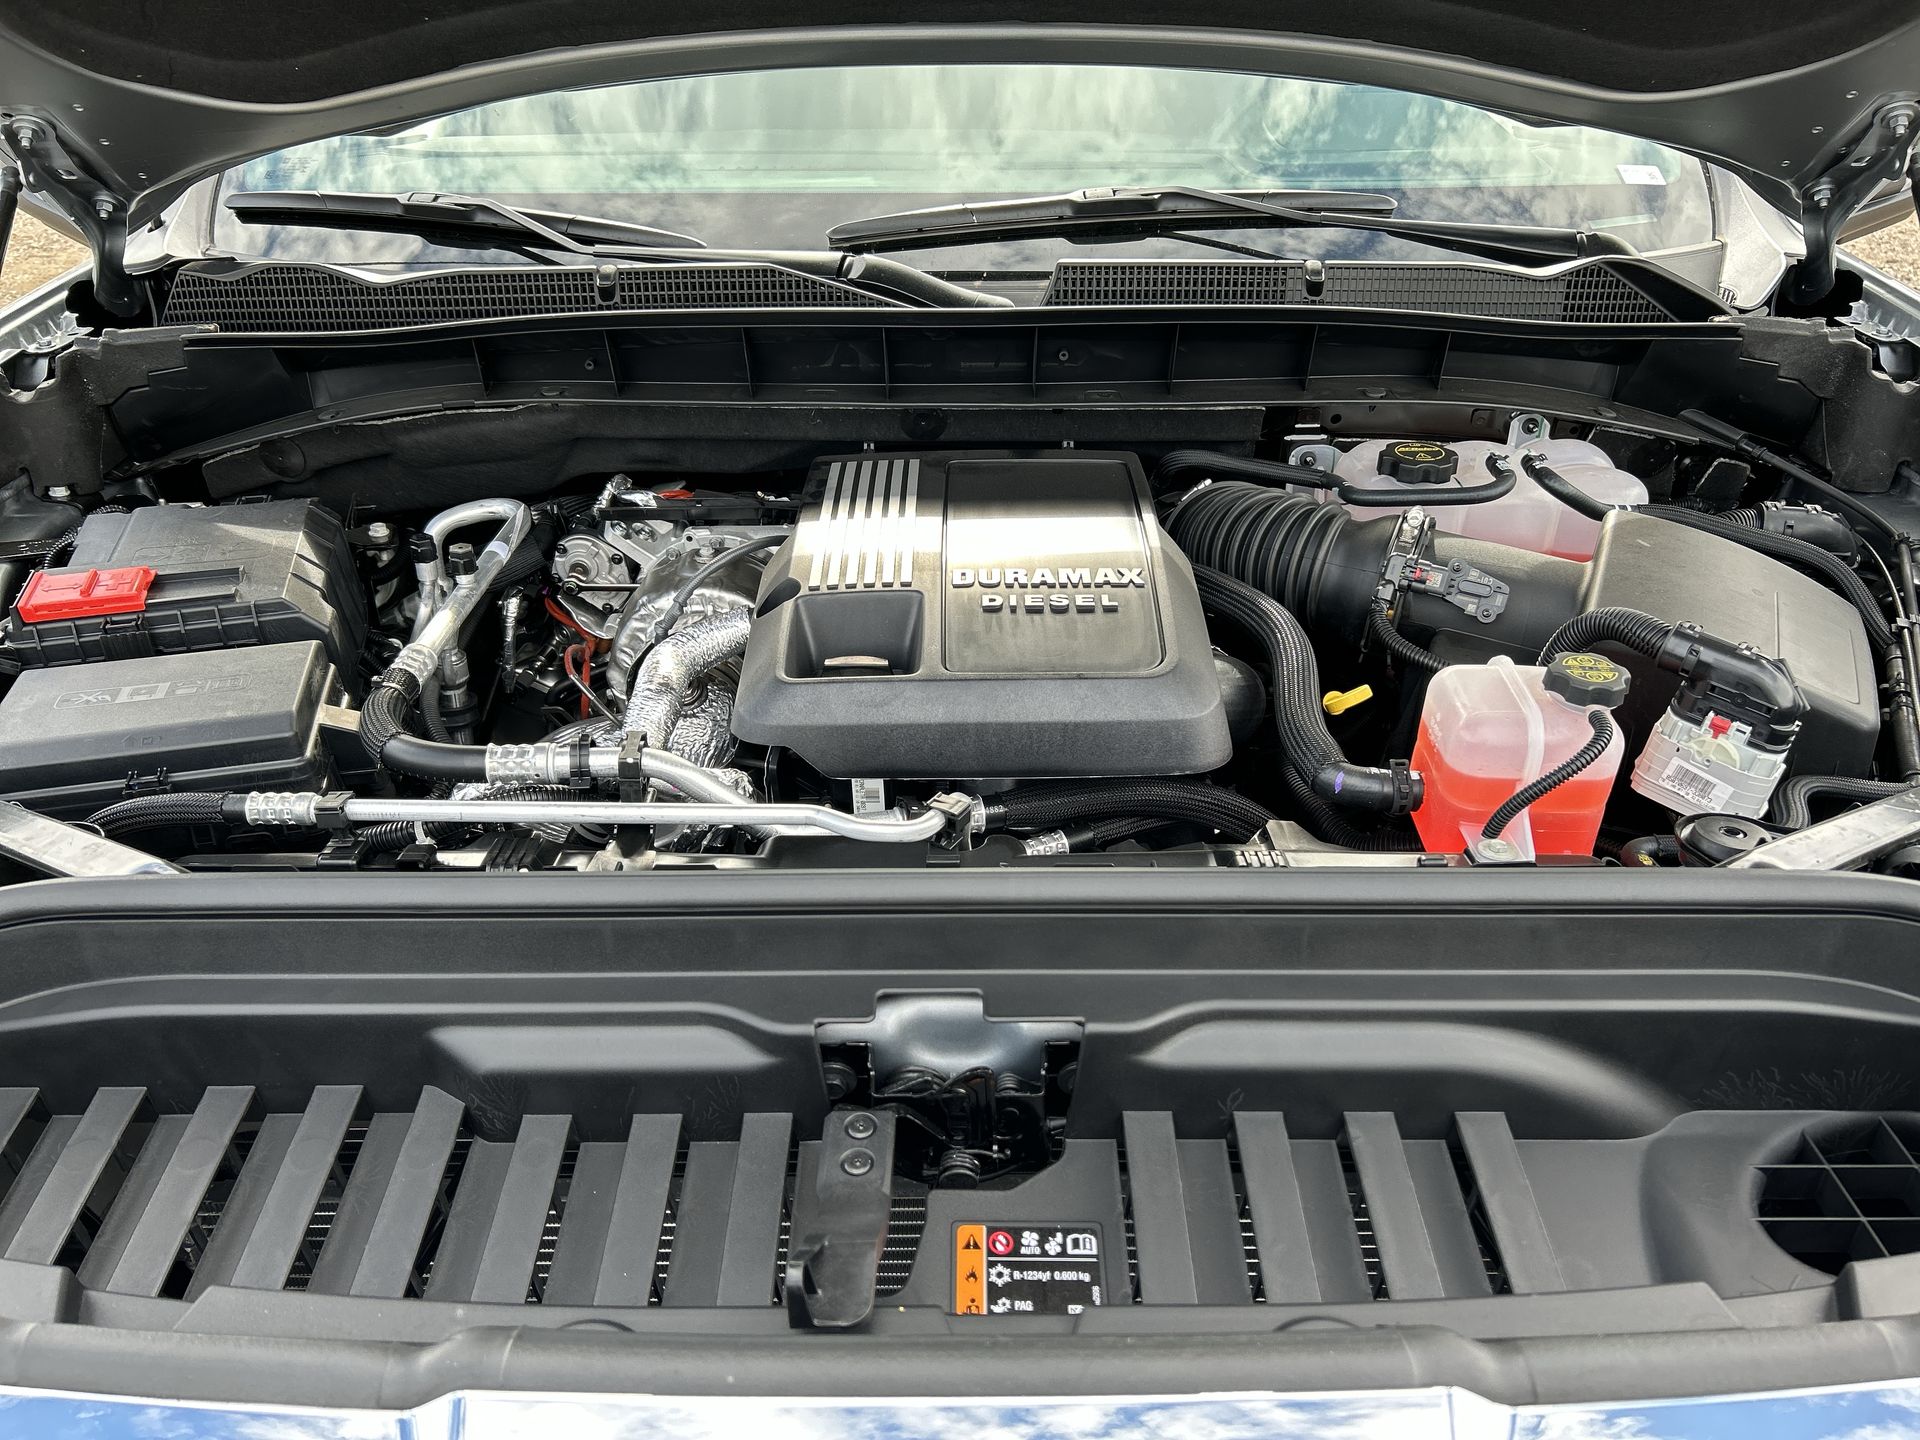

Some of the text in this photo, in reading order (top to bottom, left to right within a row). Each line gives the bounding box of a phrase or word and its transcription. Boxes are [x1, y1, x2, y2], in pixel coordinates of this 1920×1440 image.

[951, 568, 1145, 588] DURAMAX
[981, 594, 1119, 613] DIESEL
[1020, 1246, 1041, 1255] AUTO
[1013, 1270, 1091, 1283] R-1234yf 0.600 kg
[1014, 1300, 1034, 1312] PAG
